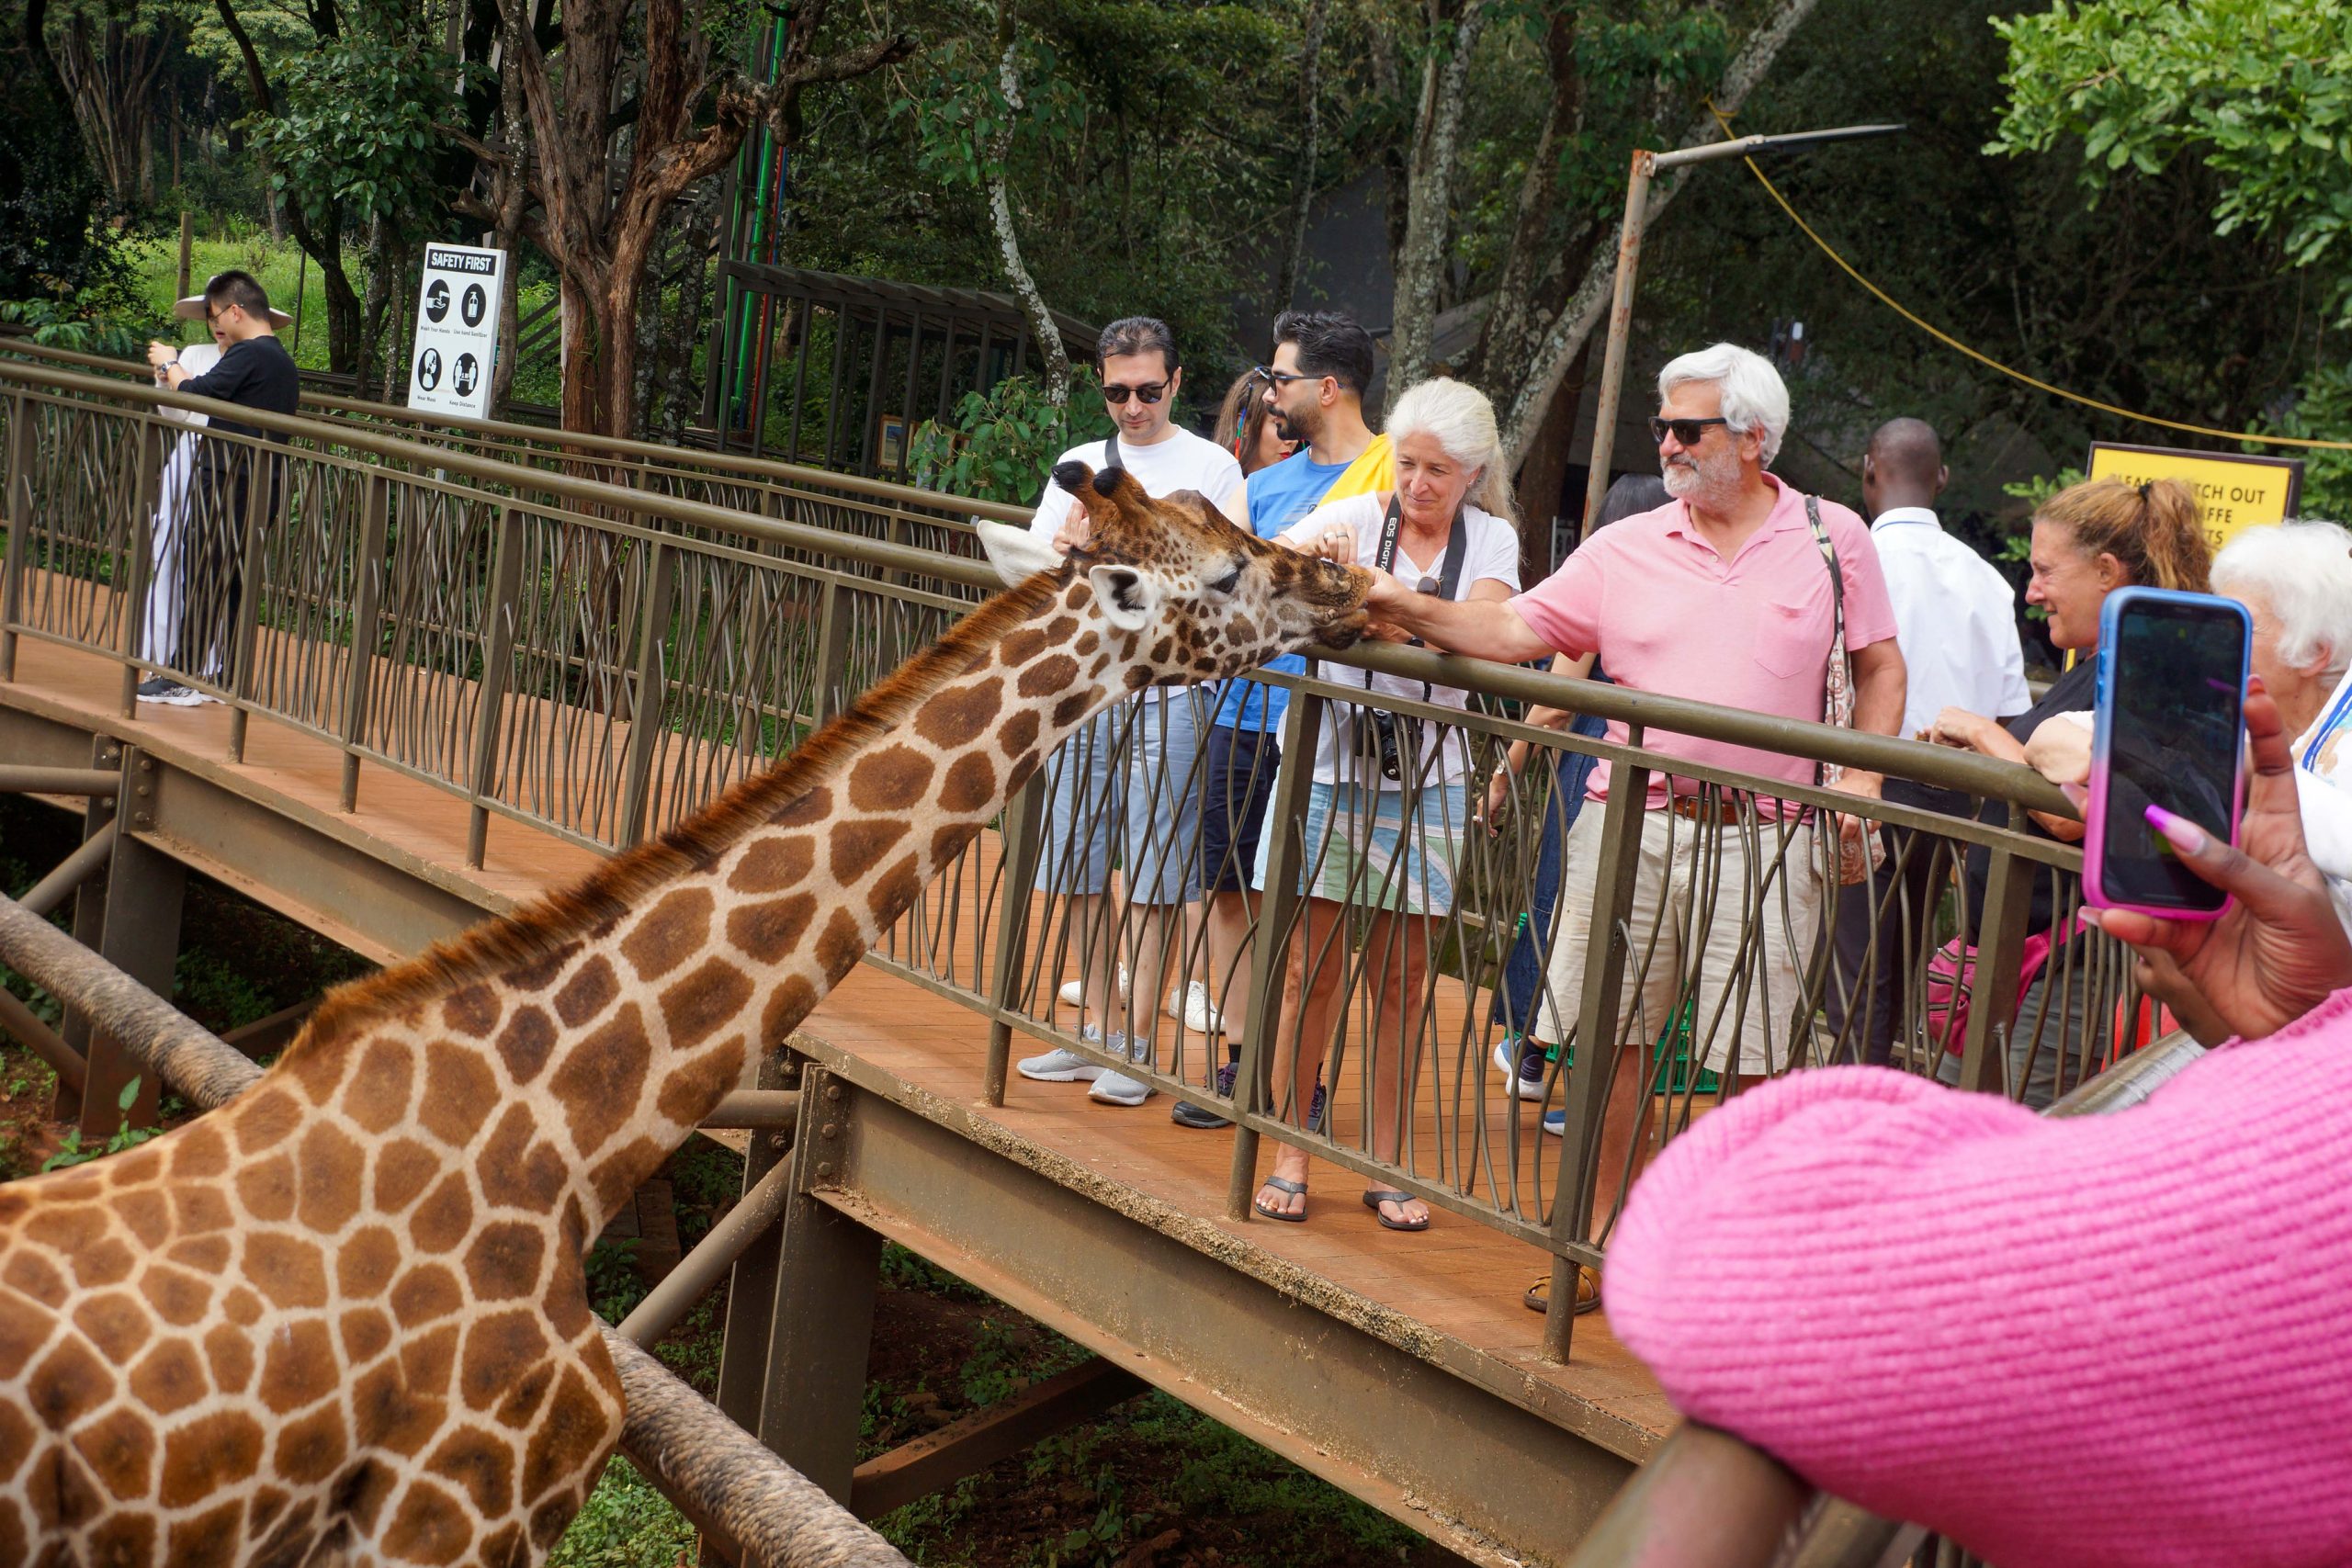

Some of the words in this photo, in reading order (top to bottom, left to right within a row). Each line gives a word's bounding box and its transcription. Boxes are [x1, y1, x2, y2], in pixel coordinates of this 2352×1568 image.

[431, 252, 465, 269] SAFETY
[465, 255, 492, 272] FIRST
[459, 400, 476, 409] Distance
[2231, 487, 2266, 504] OUT
[1385, 517, 1397, 538] EOS
[1380, 540, 1393, 570] DIGITA
